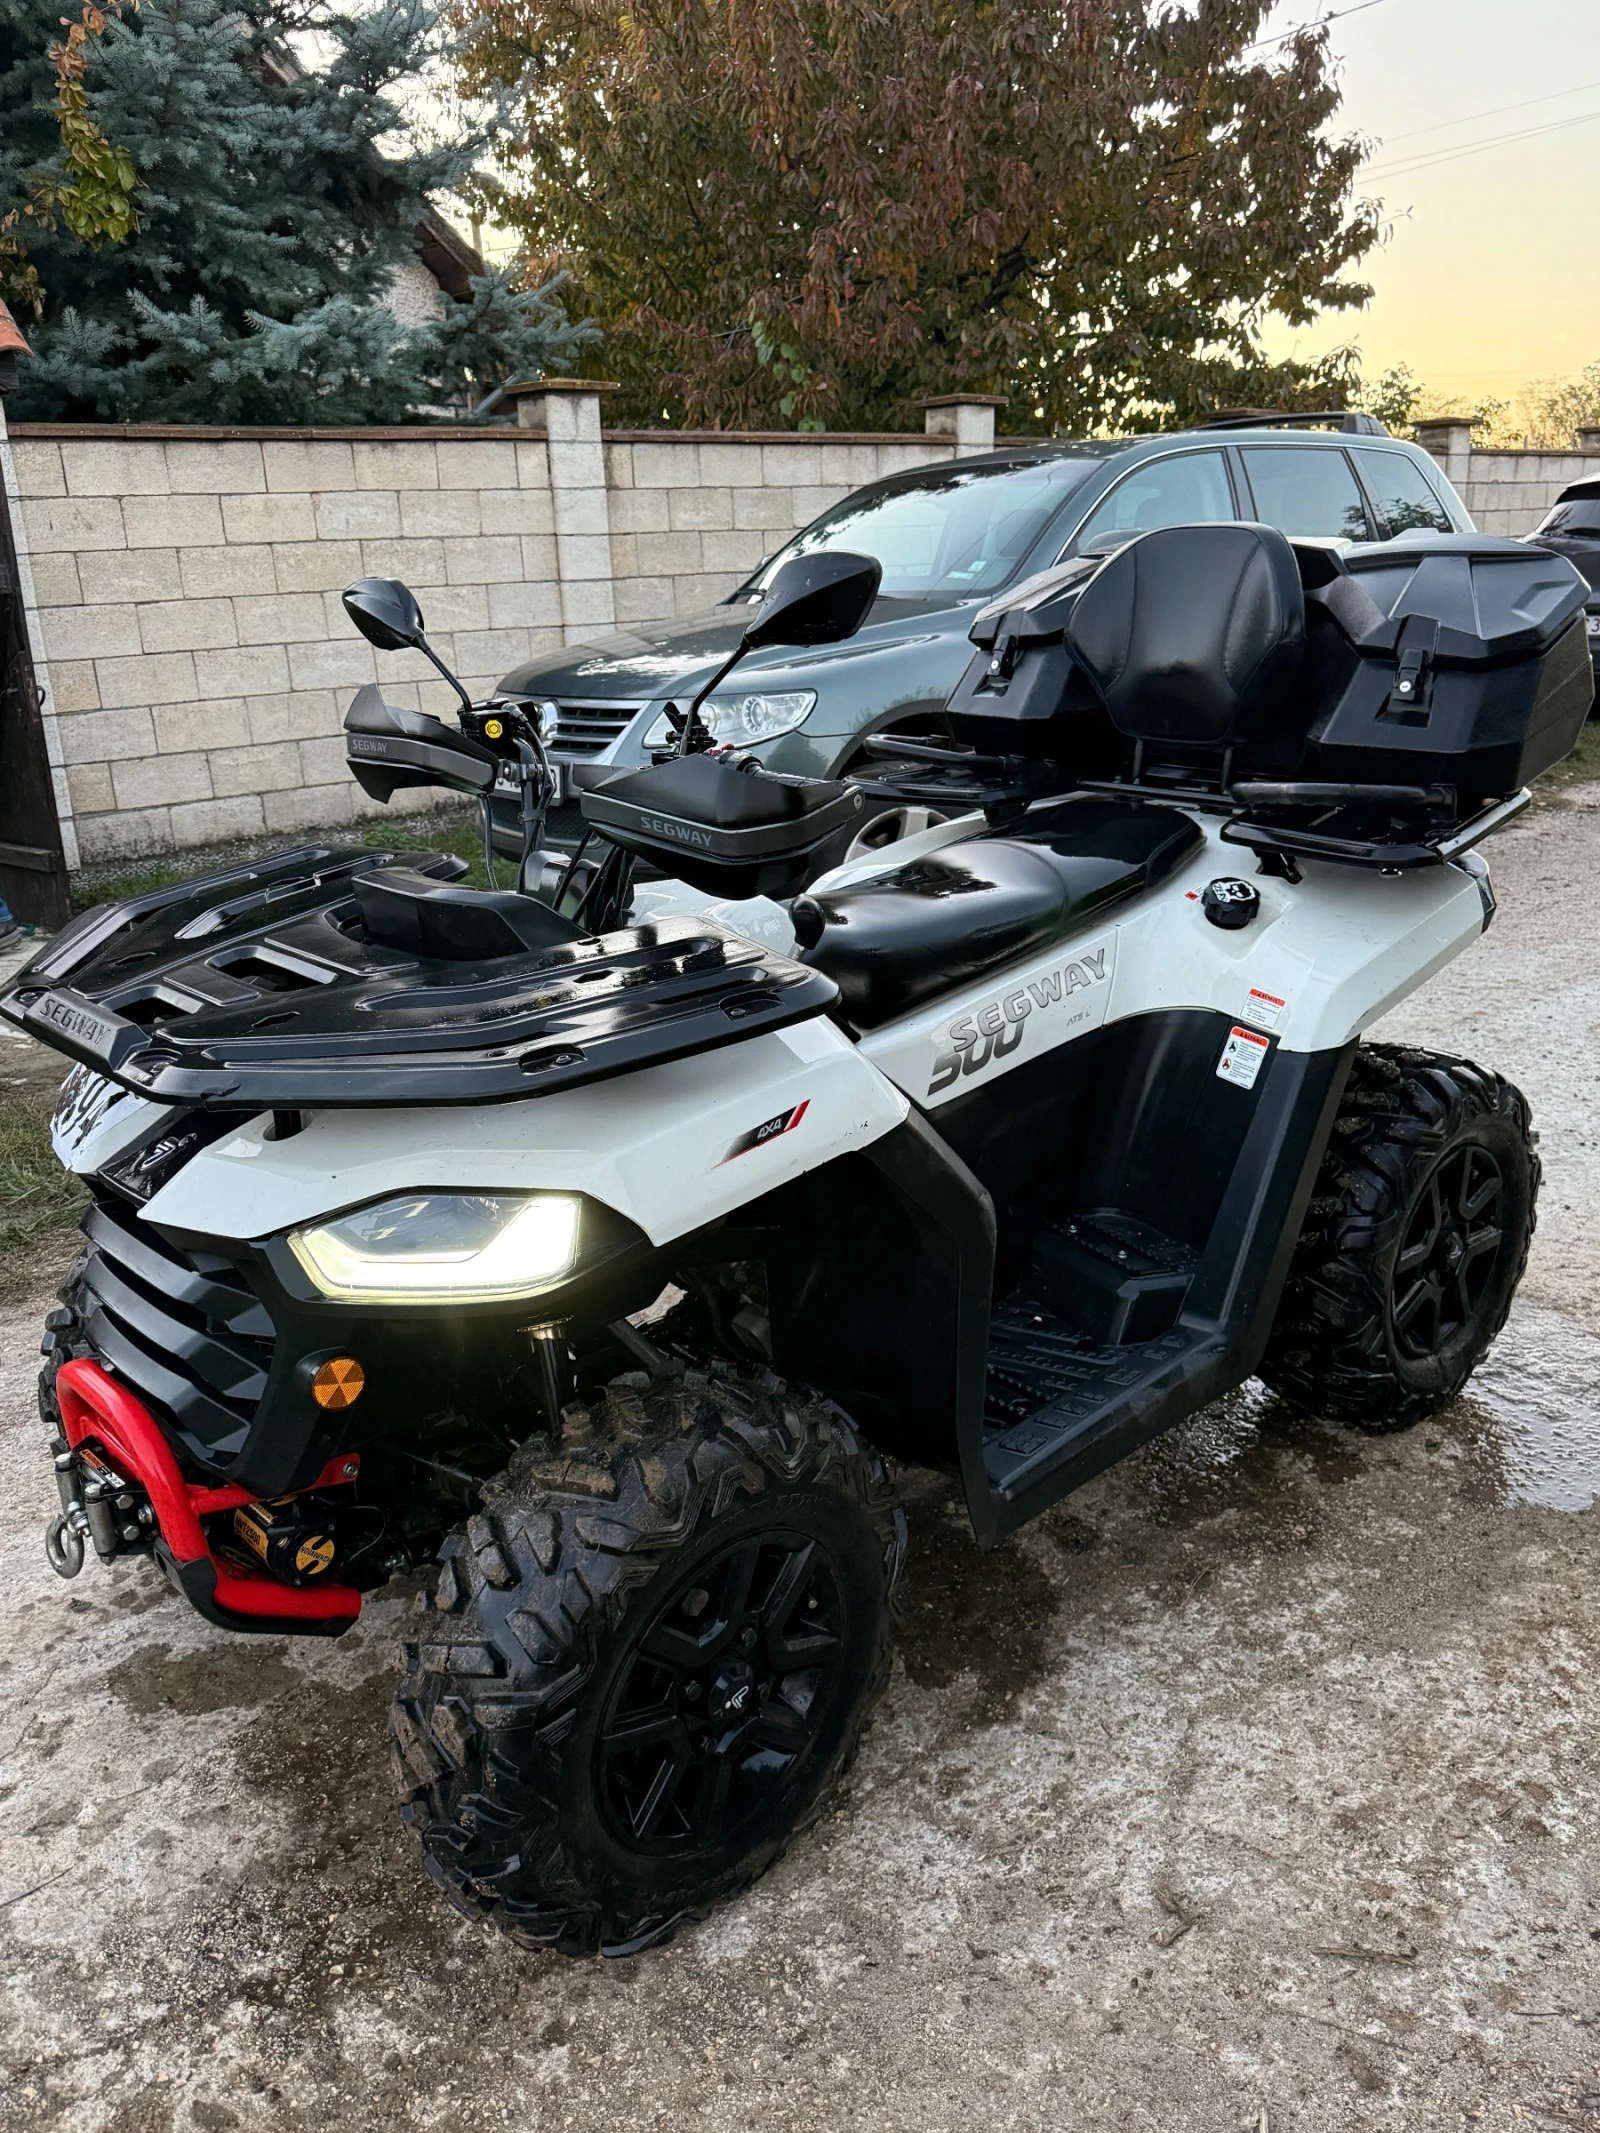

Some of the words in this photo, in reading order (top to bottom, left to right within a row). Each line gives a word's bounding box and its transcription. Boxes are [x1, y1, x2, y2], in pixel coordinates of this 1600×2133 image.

[352, 739, 388, 753] SEGWAY
[640, 816, 712, 847] SEGWAY
[949, 948, 1105, 1052] SEGWAY
[39, 999, 112, 1044] SEGWAY
[757, 1118, 782, 1140] 4X4
[299, 1545, 332, 1565] NOVAWINCH
